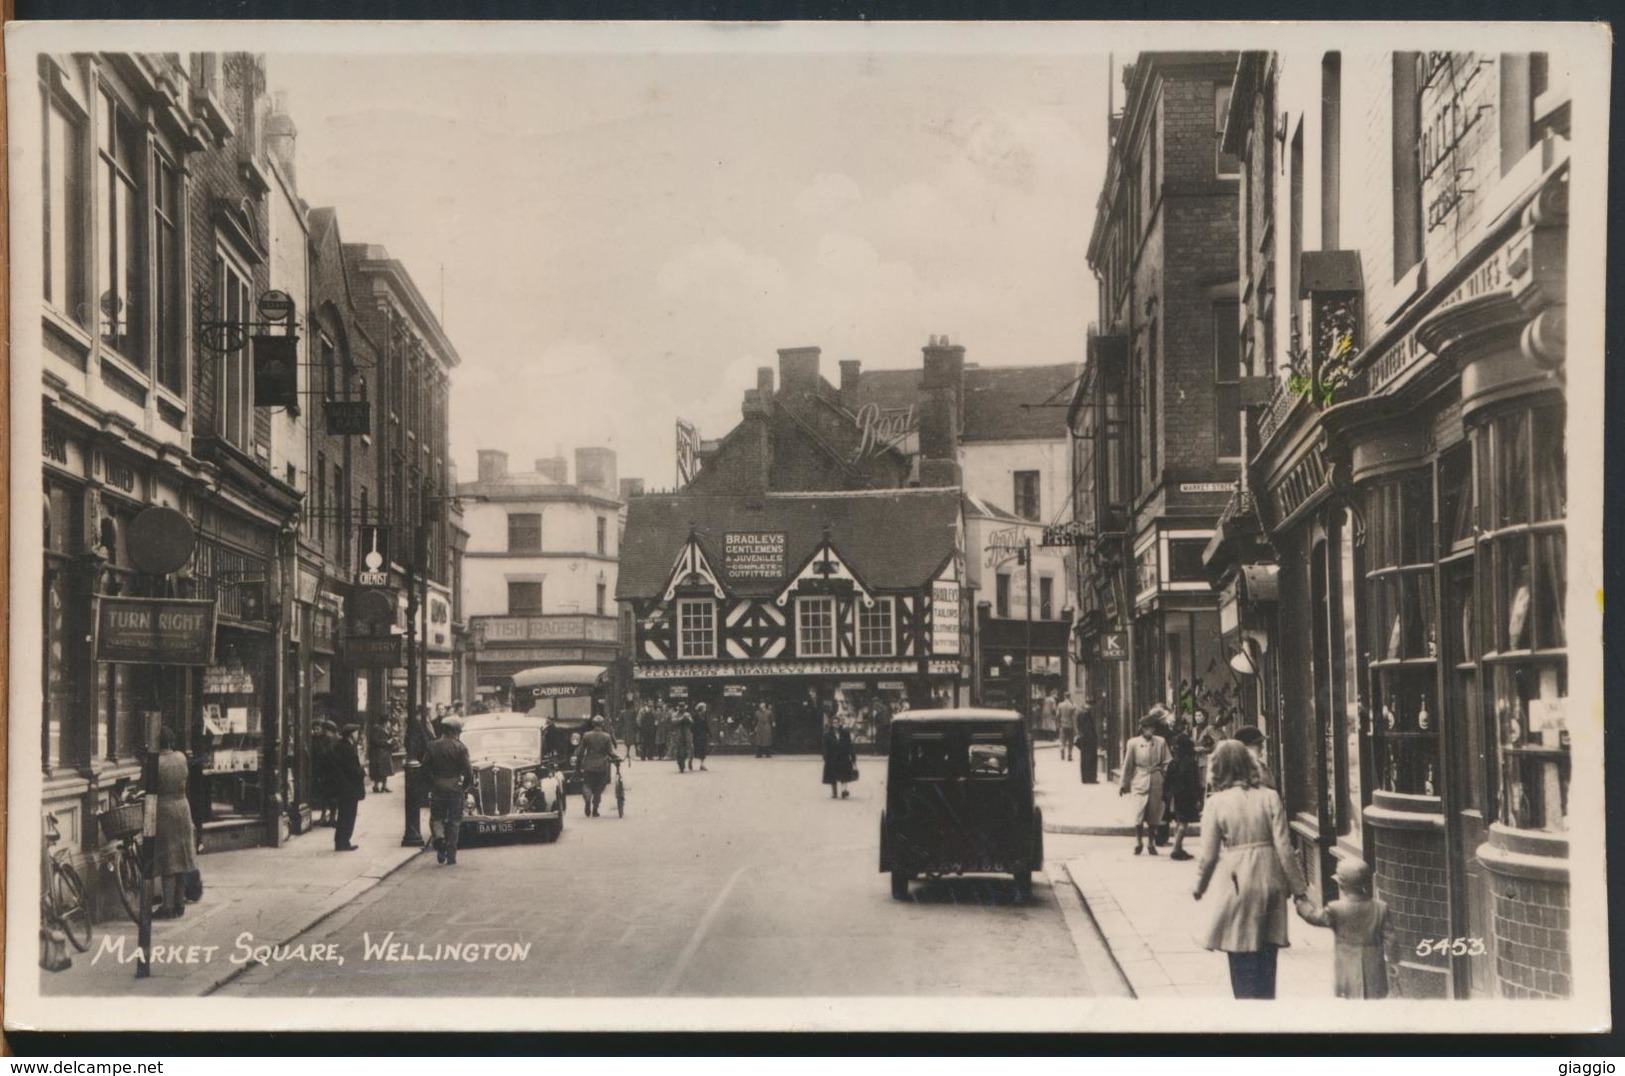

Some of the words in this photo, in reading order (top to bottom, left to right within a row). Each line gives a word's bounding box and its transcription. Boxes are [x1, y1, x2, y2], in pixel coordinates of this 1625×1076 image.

[726, 534, 785, 544] BRADLEYS
[360, 572, 388, 586] CHEMIST
[108, 610, 150, 629] TURN
[158, 612, 204, 630] RIGHT
[1107, 635, 1120, 650] K
[532, 686, 578, 696] CADBURY
